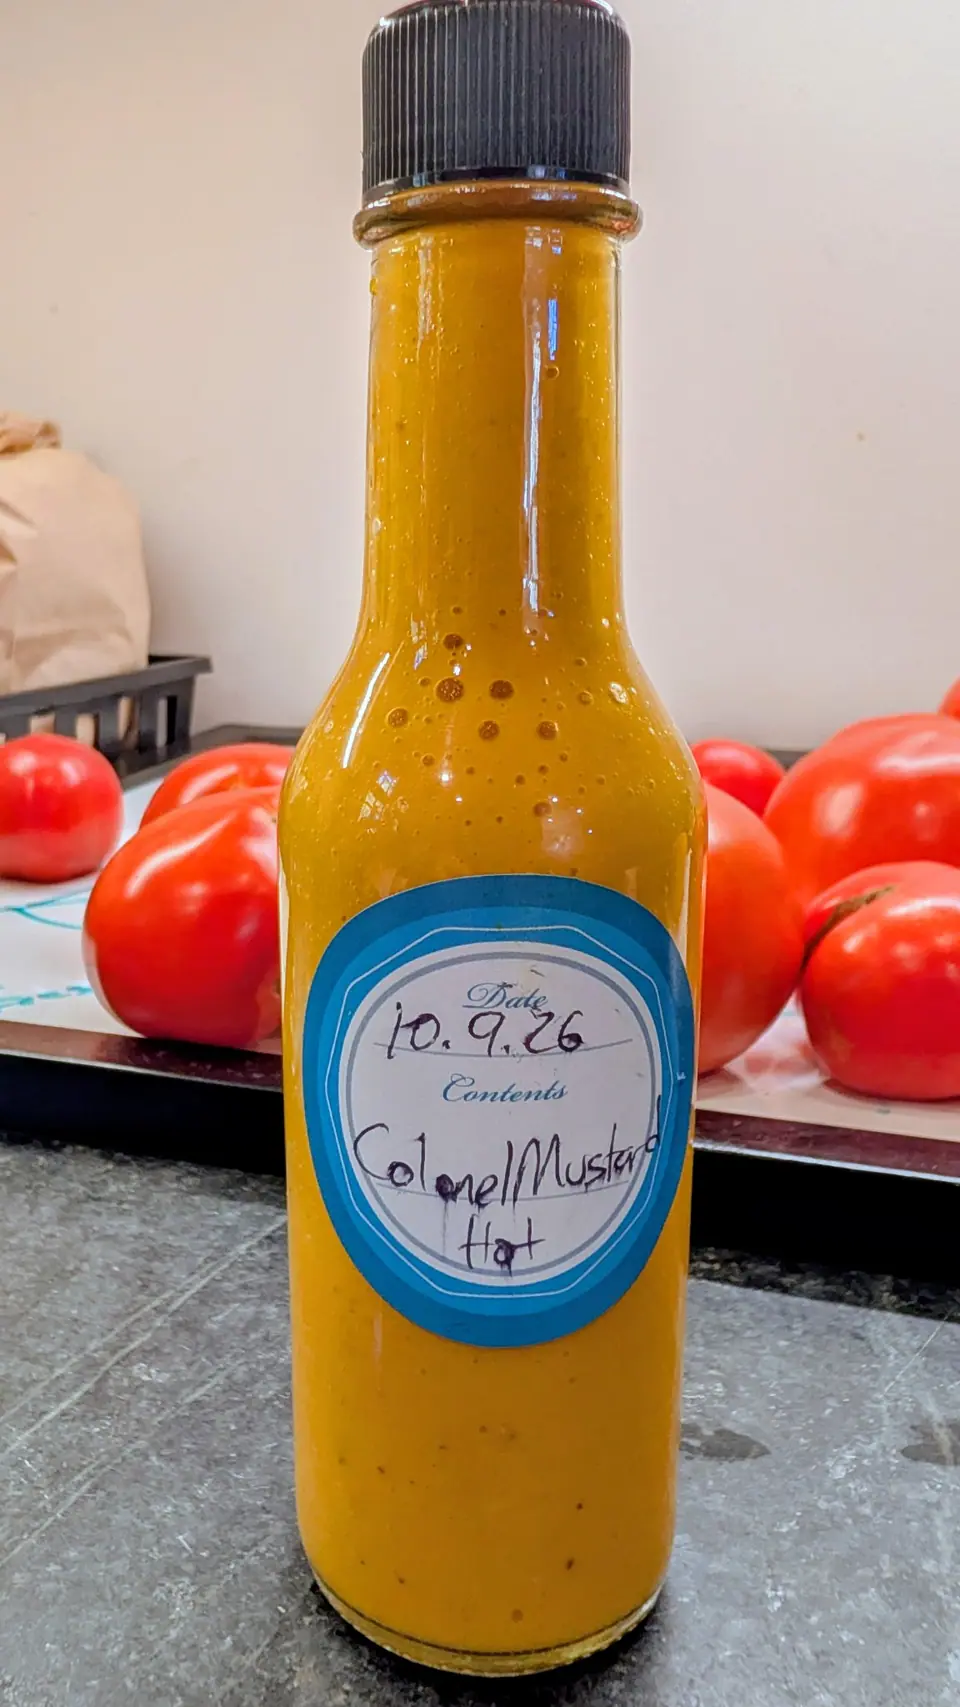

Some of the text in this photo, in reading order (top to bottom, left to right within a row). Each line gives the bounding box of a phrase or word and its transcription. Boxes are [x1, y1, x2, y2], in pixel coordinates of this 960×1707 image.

[462, 982, 548, 1010] Date
[442, 1073, 568, 1102] Contents
[353, 1094, 661, 1207] Colonel Mustard
[458, 1213, 546, 1276] Hot
